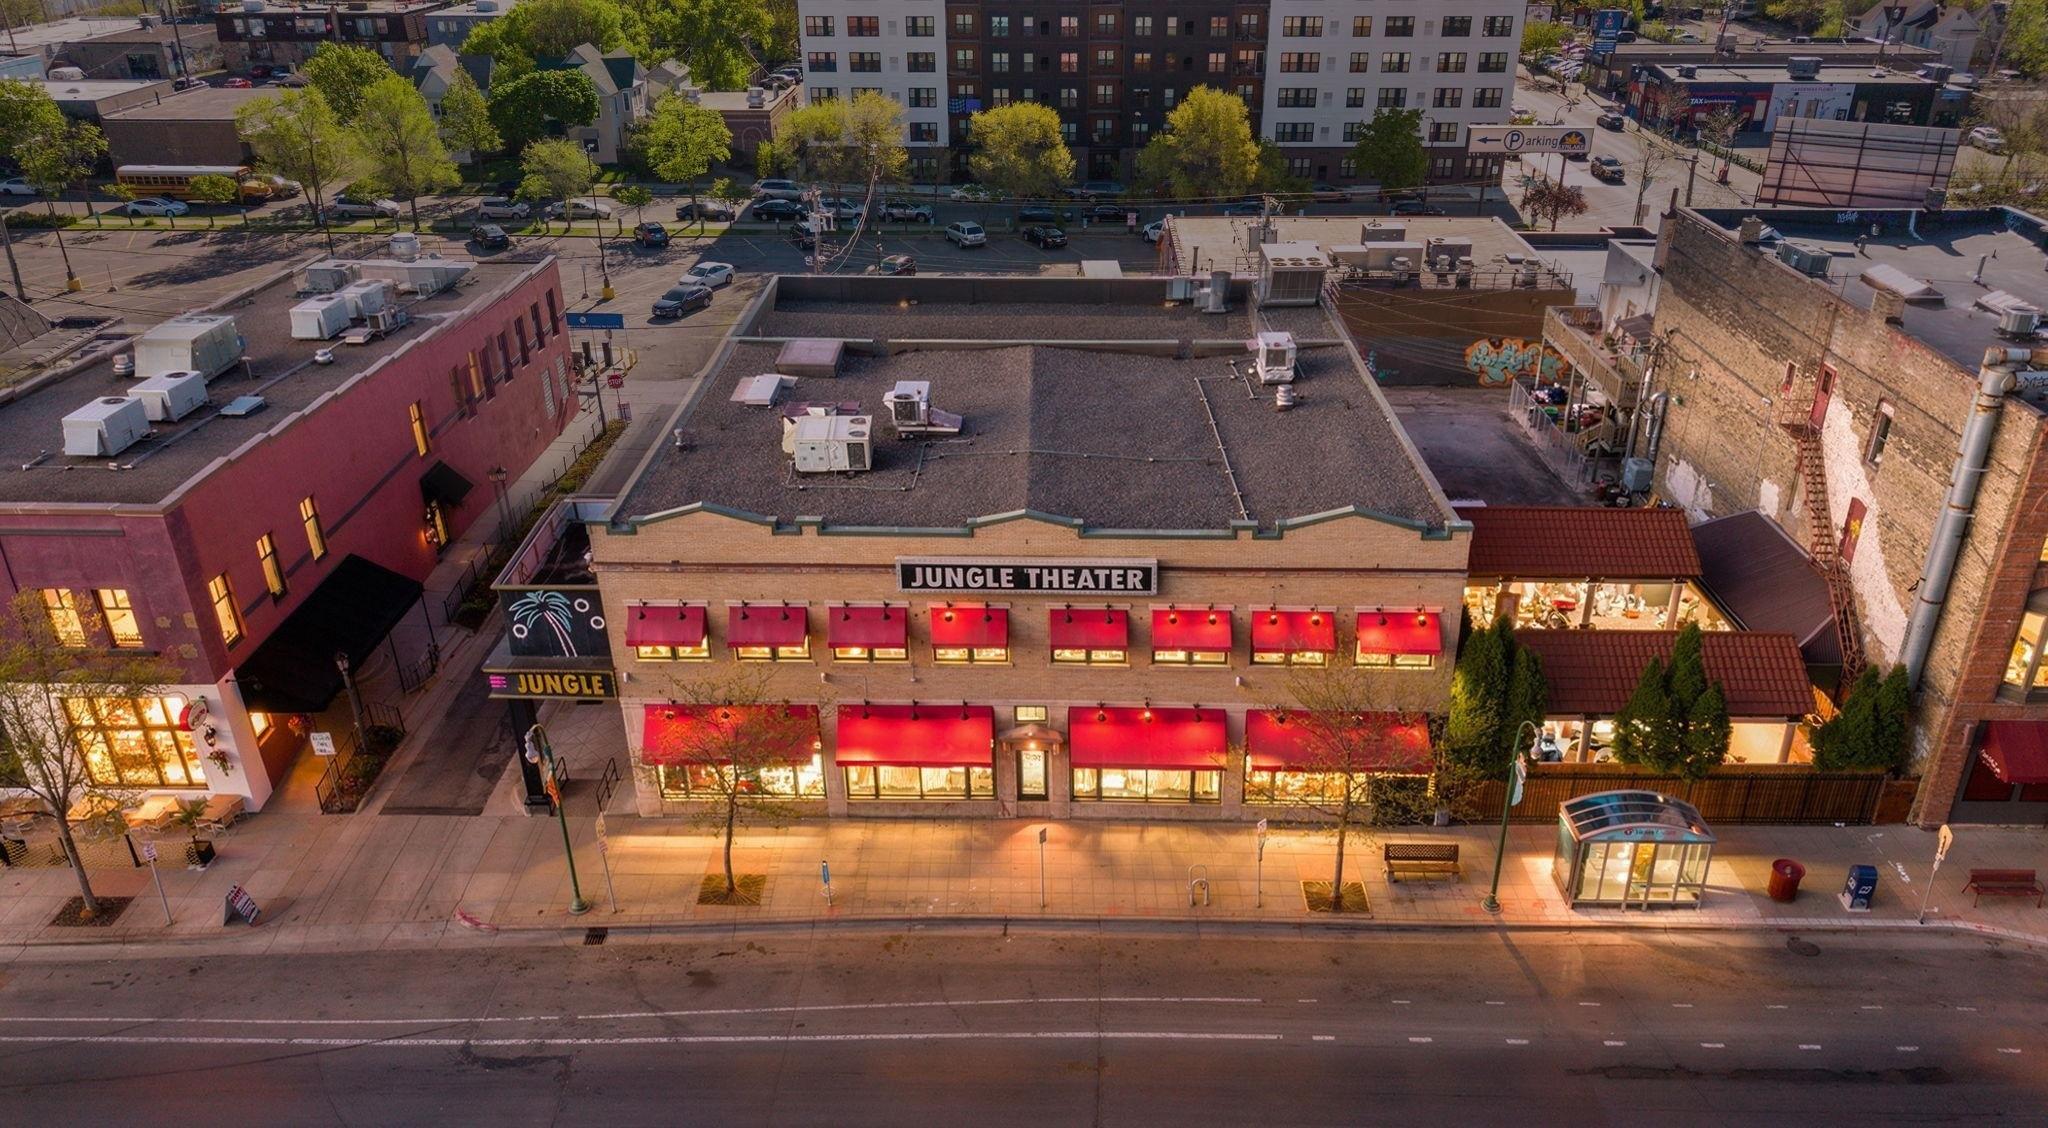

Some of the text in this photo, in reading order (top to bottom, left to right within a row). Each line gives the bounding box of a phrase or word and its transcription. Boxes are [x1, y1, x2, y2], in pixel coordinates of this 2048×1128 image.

[1509, 132, 1559, 149] Parking
[911, 566, 1143, 590] JUNGLE THEATER
[518, 674, 605, 695] JUNGLE
